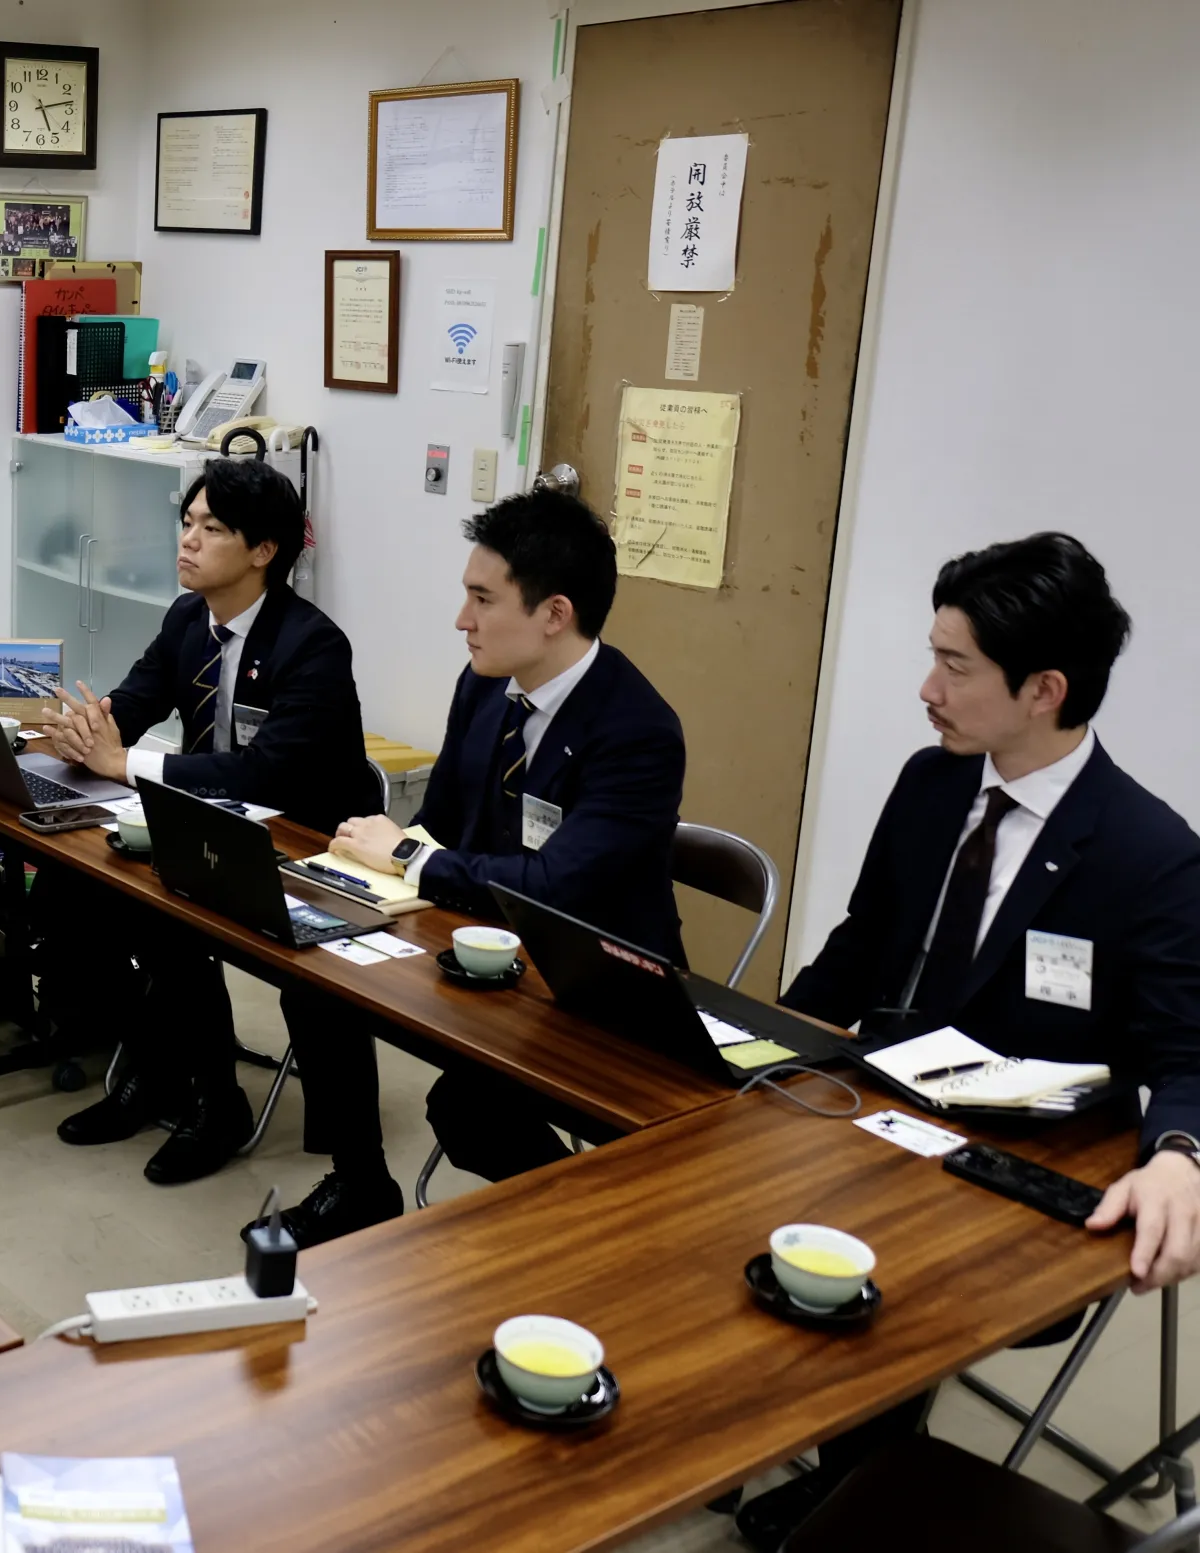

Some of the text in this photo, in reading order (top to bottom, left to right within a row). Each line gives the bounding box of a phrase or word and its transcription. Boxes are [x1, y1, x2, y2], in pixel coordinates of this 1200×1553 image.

[24, 71, 31, 82] 11
[36, 69, 48, 81] 12
[55, 73, 58, 84] 1
[11, 82, 22, 93] 10
[62, 84, 71, 95] 2
[9, 100, 18, 112] 9
[65, 104, 74, 115] 3
[11, 118, 20, 130] 8
[61, 120, 70, 133] 4
[23, 130, 32, 142] 7
[36, 134, 45, 146] 6
[51, 132, 59, 144] 5
[680, 162, 706, 268] 開放厳禁
[55, 286, 84, 301] カンペ
[42, 304, 96, 316] タイムキーパー
[660, 404, 708, 414] 従業員の皆様へ
